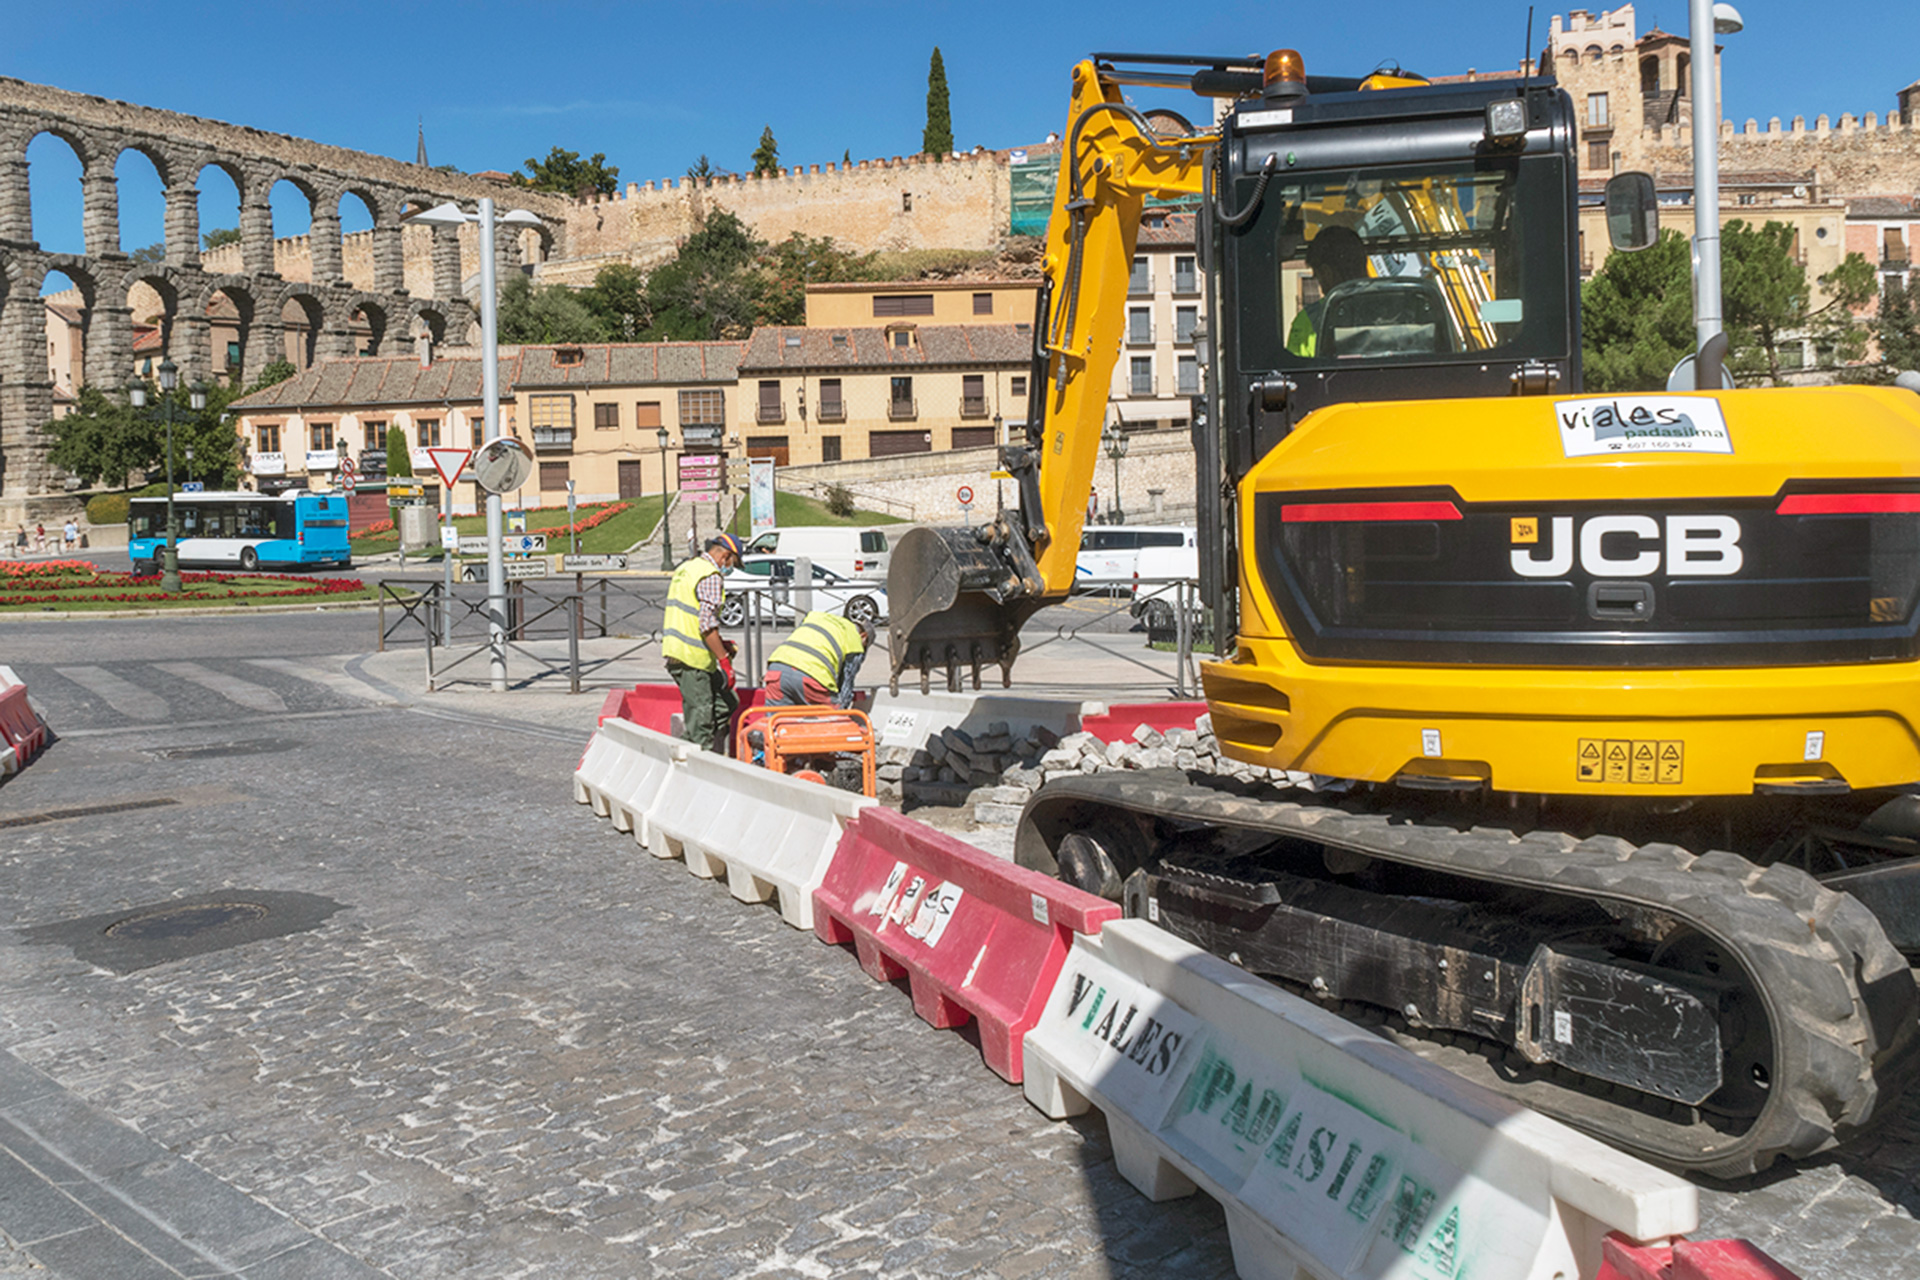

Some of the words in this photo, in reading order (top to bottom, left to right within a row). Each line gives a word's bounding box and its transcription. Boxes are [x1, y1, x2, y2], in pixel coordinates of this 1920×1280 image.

[1562, 400, 1682, 430] viales
[1624, 426, 1724, 440] padasilma
[1510, 515, 1744, 577] JCB
[1067, 972, 1184, 1077] VIALES
